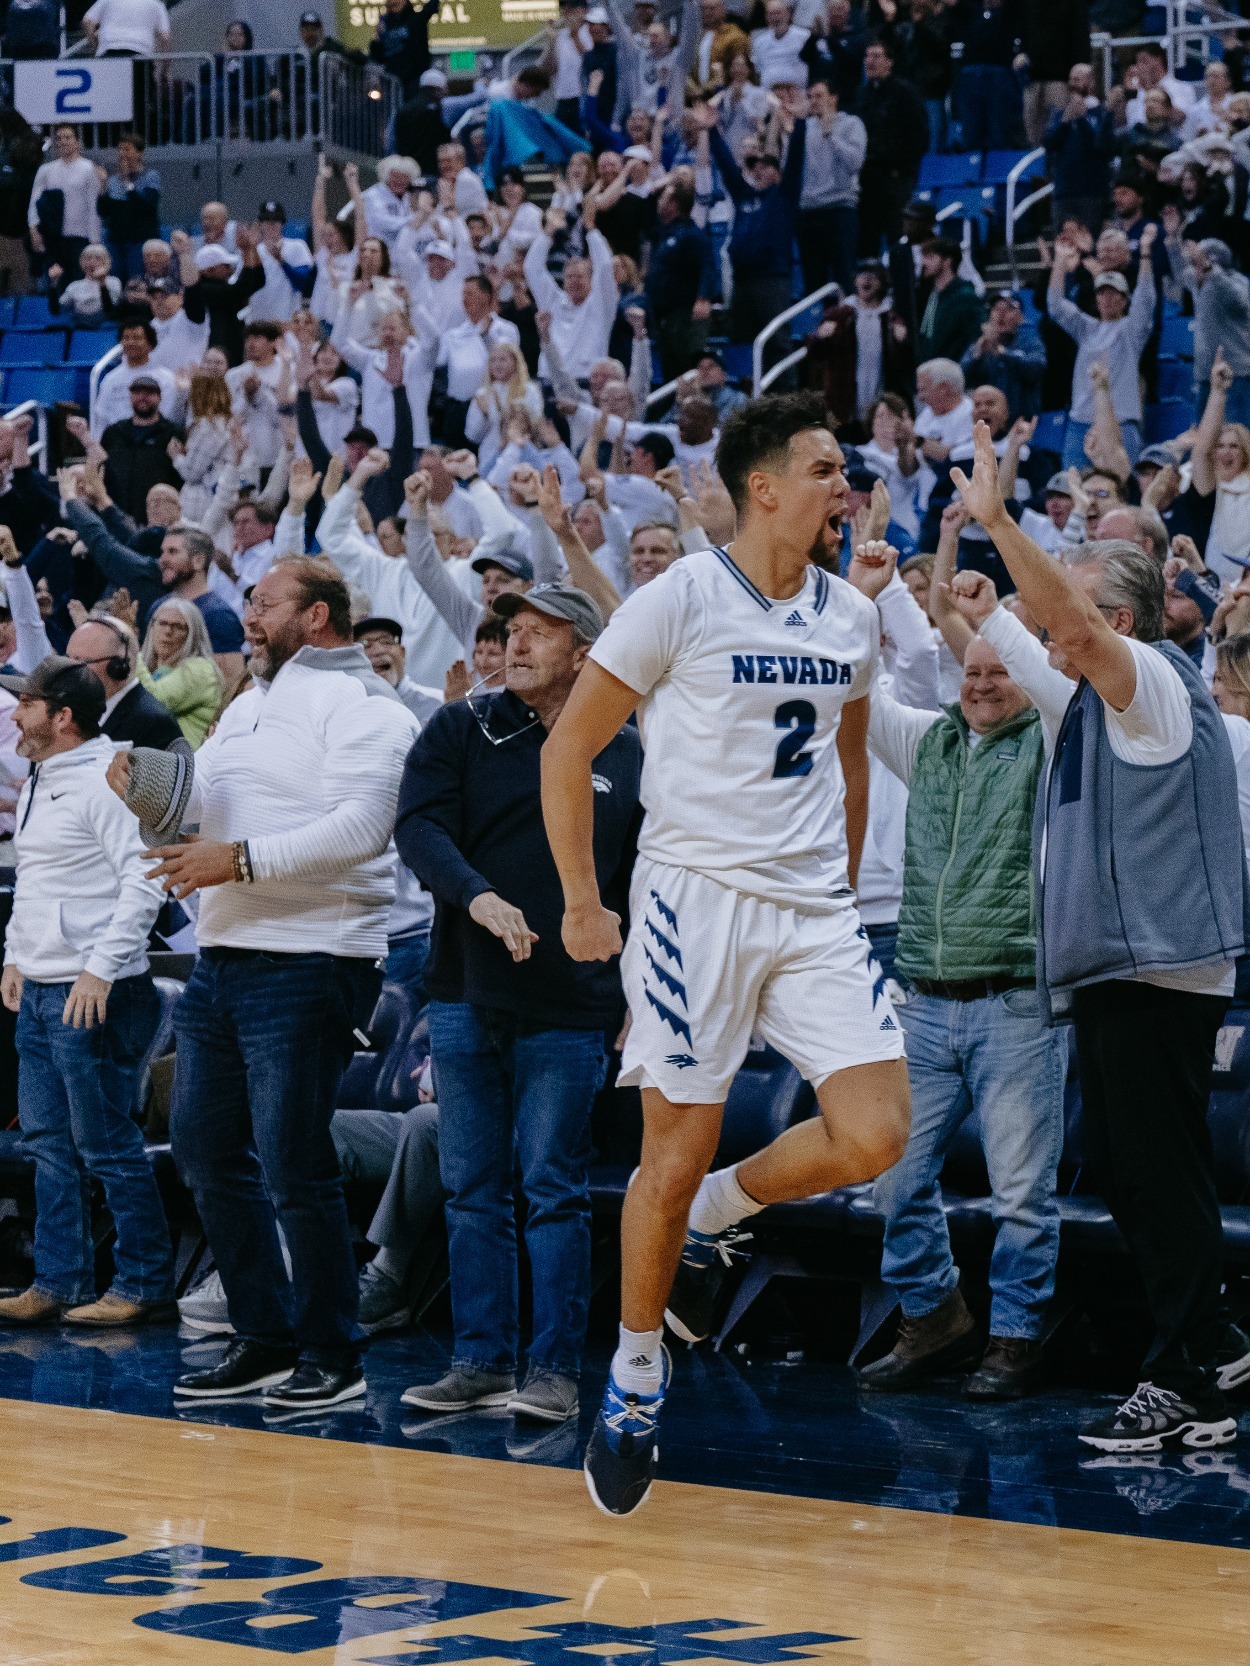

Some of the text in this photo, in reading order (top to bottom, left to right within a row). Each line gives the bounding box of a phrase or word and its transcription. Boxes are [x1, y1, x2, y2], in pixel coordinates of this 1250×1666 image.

[55, 69, 92, 114] 2
[731, 655, 852, 685] NEVADA
[771, 698, 817, 780] 2
